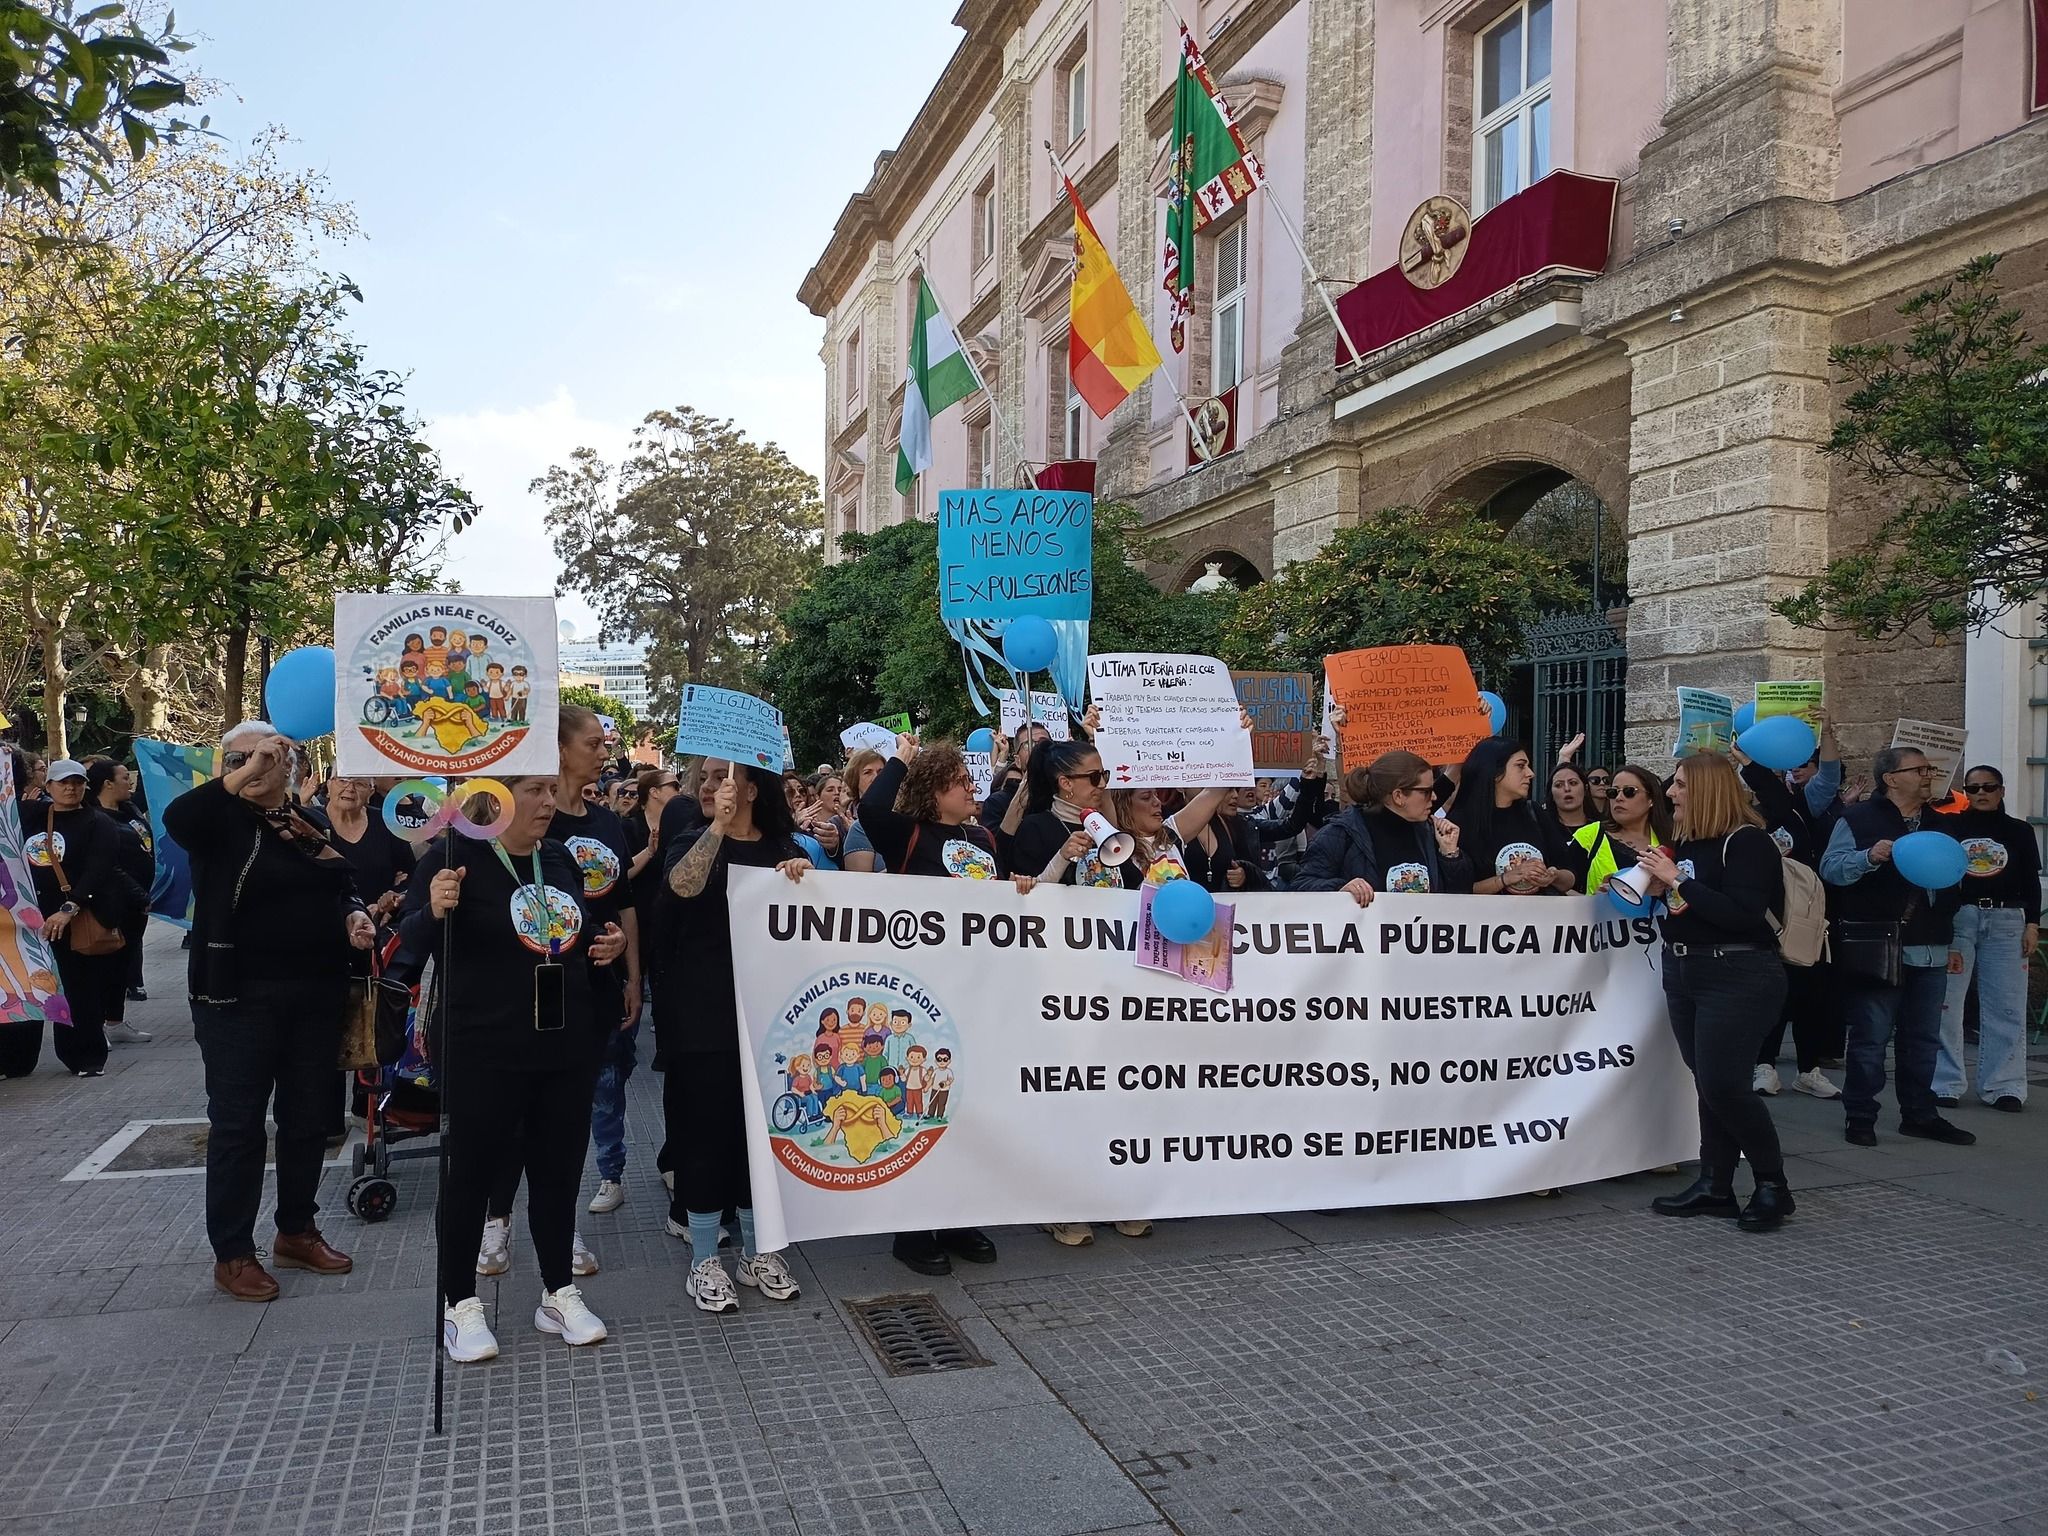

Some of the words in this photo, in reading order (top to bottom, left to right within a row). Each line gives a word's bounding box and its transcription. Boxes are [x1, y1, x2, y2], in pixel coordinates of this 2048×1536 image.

[945, 495, 1003, 528] MAS
[1010, 495, 1087, 528] APOYO
[971, 530, 1064, 559] MENOS
[369, 605, 431, 646] FAMILIAS
[434, 605, 475, 621] NEAE
[477, 612, 518, 646] CÁDIZ
[1091, 660, 1136, 678] ULTIMA
[1176, 663, 1188, 675] EN
[1189, 664, 1199, 675] EL
[1199, 663, 1216, 675] COLE
[1337, 646, 1434, 672] FIBROSIS
[1360, 666, 1451, 685] QUISTICA
[1142, 678, 1156, 688] DE
[1395, 718, 1424, 730] CURA
[375, 734, 425, 766] LUCHANDO
[426, 758, 448, 770] POR
[449, 757, 469, 770] SUS
[469, 734, 516, 766] DERECHOS
[767, 903, 948, 950] UNID@S
[961, 911, 1049, 949] POR
[1232, 922, 1365, 955] CUELA
[1379, 915, 1542, 955] PÚBLICA
[784, 972, 851, 1025] FAMILIAS
[854, 971, 901, 992] NEAE
[902, 983, 943, 1023] CÁDIZ
[1039, 994, 1110, 1021] SUS
[1120, 995, 1297, 1022] DERECHOS
[1304, 996, 1369, 1022] SON
[1380, 993, 1513, 1021] NUESTRA
[1520, 988, 1597, 1017] LUCHA
[1019, 1064, 1106, 1093] NEAE
[1116, 1063, 1186, 1091] CON
[1197, 1061, 1382, 1092] RECURSOS,
[1389, 1060, 1429, 1086] NO
[1439, 1058, 1498, 1084] CON
[1505, 1042, 1636, 1081] EXCUSAS
[1107, 1137, 1152, 1166] SU
[1162, 1131, 1293, 1163] FUTURO
[1302, 1131, 1343, 1157] SE
[1353, 1123, 1498, 1157] DEFIENDE
[1502, 1115, 1571, 1147] HOY
[780, 1143, 832, 1182] LUCHANDO
[833, 1172, 855, 1185] POR
[856, 1171, 877, 1184] SUS
[877, 1134, 930, 1178] DERECHOS
